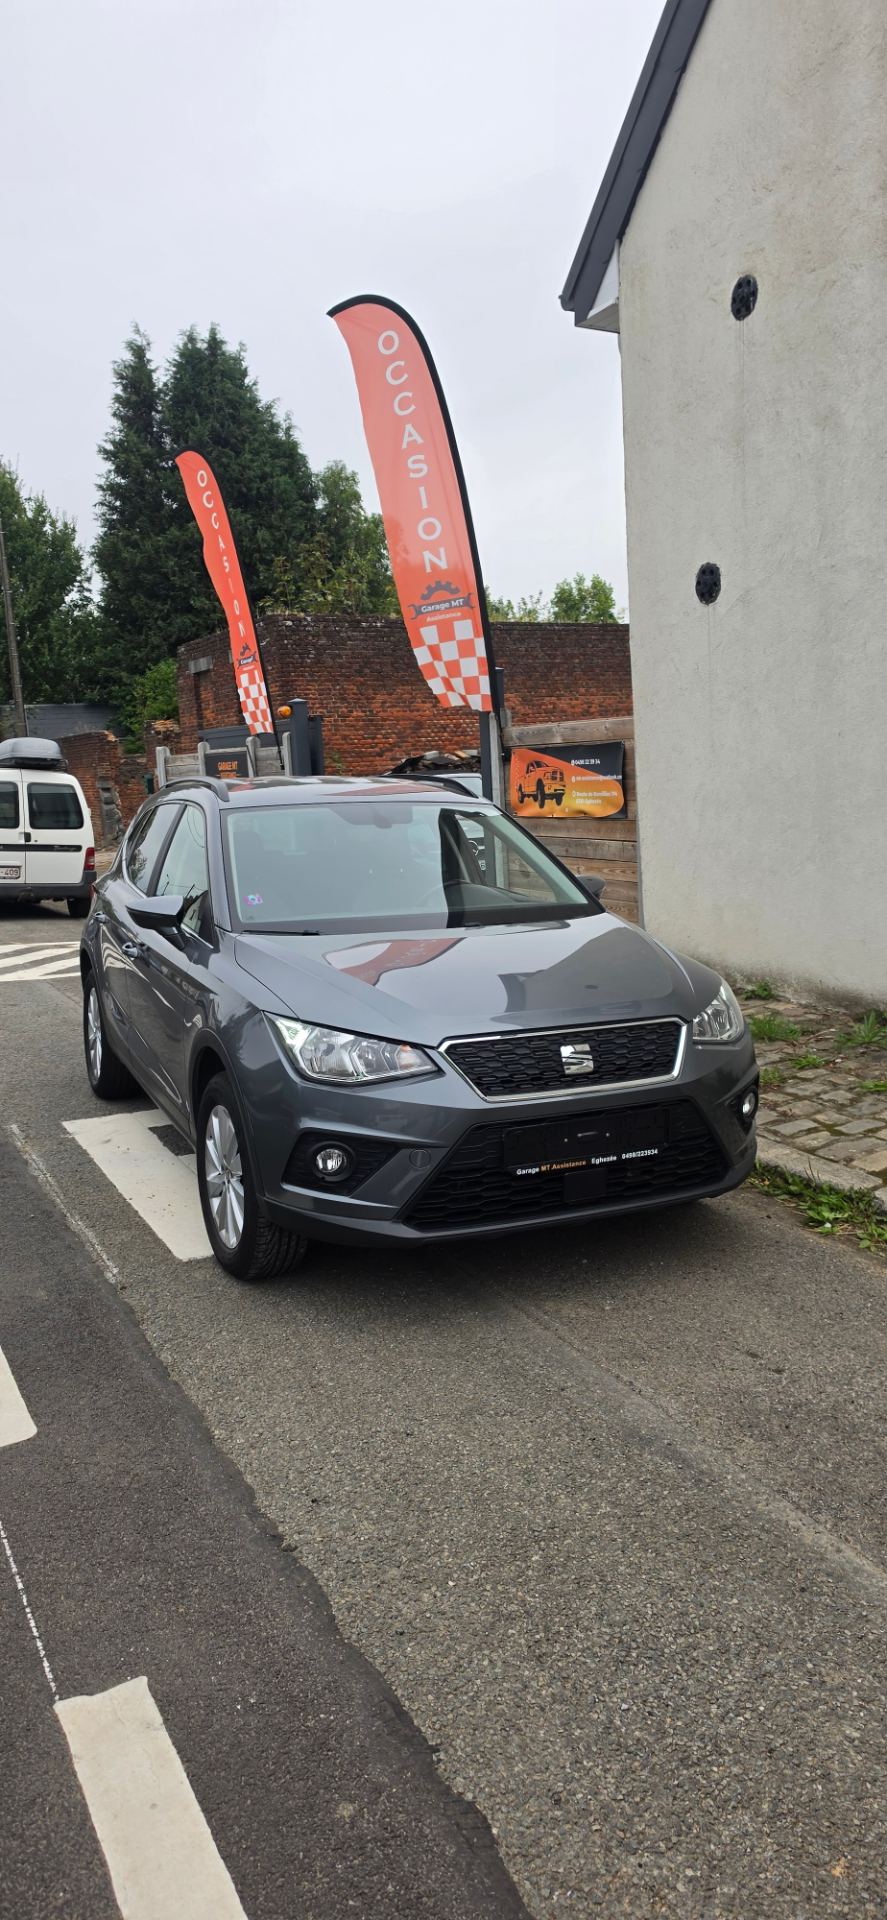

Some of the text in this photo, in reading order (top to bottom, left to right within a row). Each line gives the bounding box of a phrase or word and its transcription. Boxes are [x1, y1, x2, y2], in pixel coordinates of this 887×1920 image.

[377, 330, 448, 575] OCCASION
[197, 469, 246, 638] OCCASION
[421, 598, 465, 613] Garage MT
[516, 1167, 540, 1175] Garage
[541, 1164, 551, 1172] MT
[551, 1160, 587, 1170] Assistance
